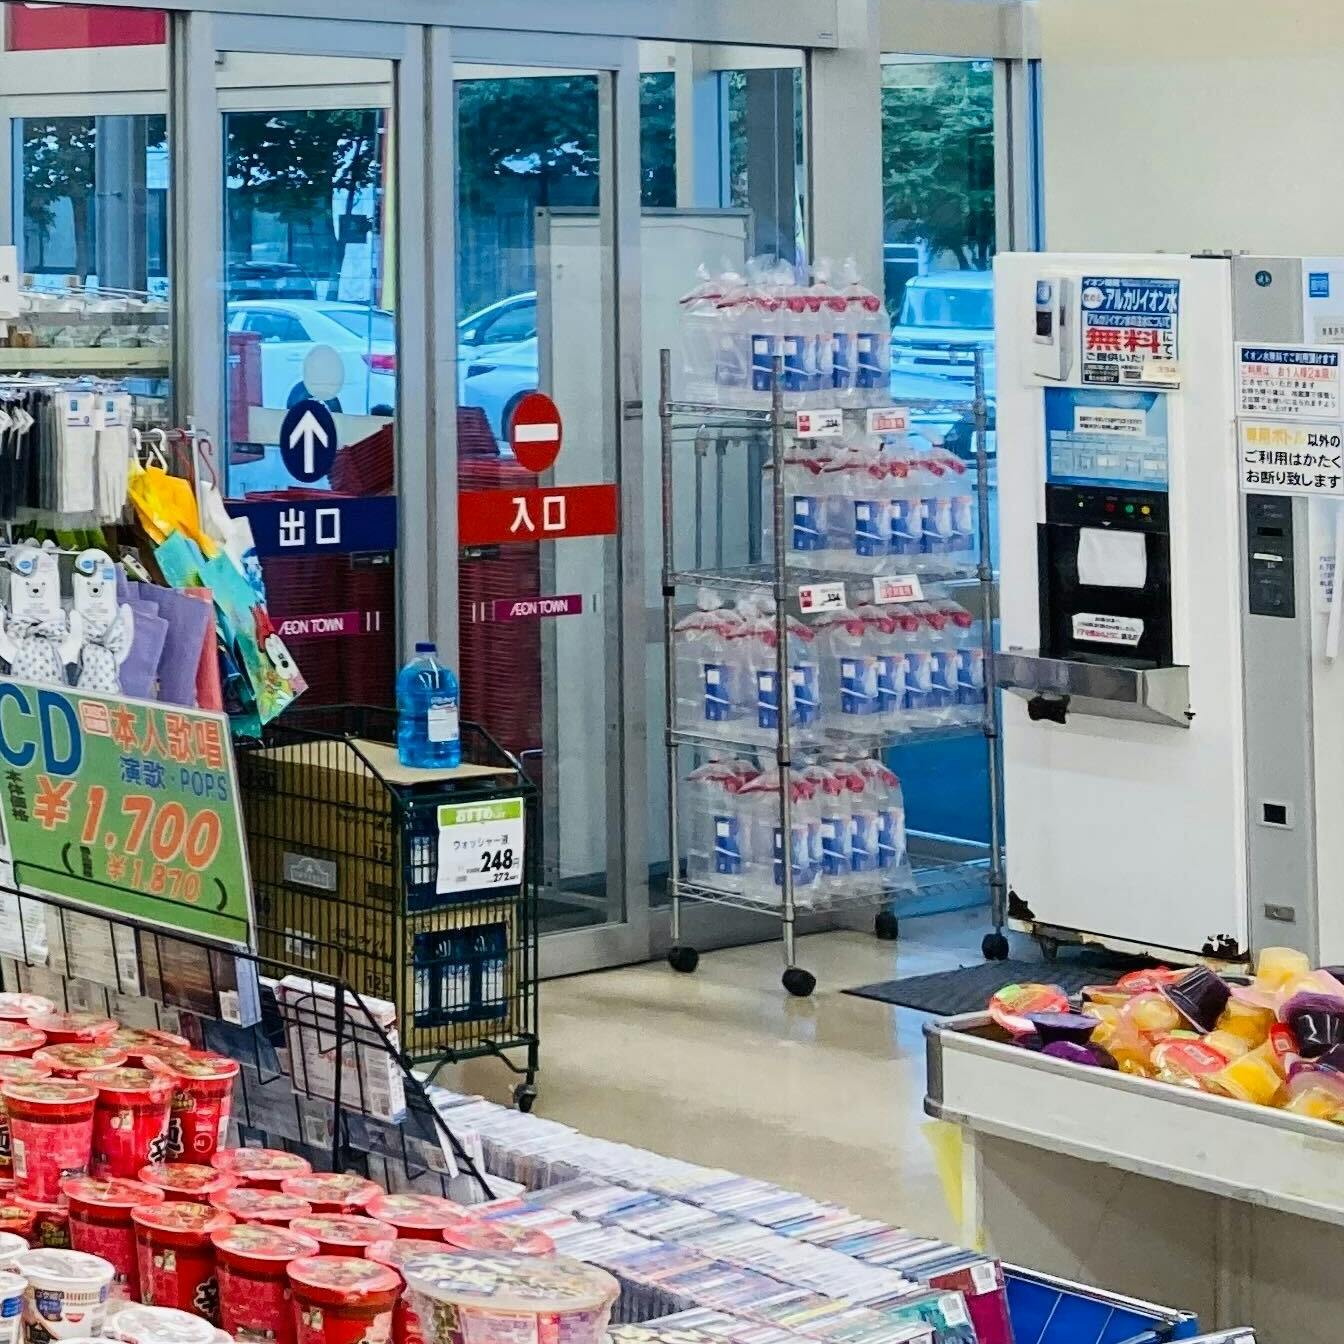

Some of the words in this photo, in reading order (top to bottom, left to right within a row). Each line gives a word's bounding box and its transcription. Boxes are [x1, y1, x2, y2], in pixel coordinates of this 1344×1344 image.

[1104, 287, 1178, 313] アルカリイオン水
[1086, 327, 1161, 354] 無料
[1244, 450, 1342, 469] ご利用はかたく
[1245, 468, 1342, 489] お断り致します
[509, 495, 566, 533] 入口
[278, 507, 341, 548] 出口
[539, 599, 569, 614] TOWN
[310, 617, 344, 633] TOWN
